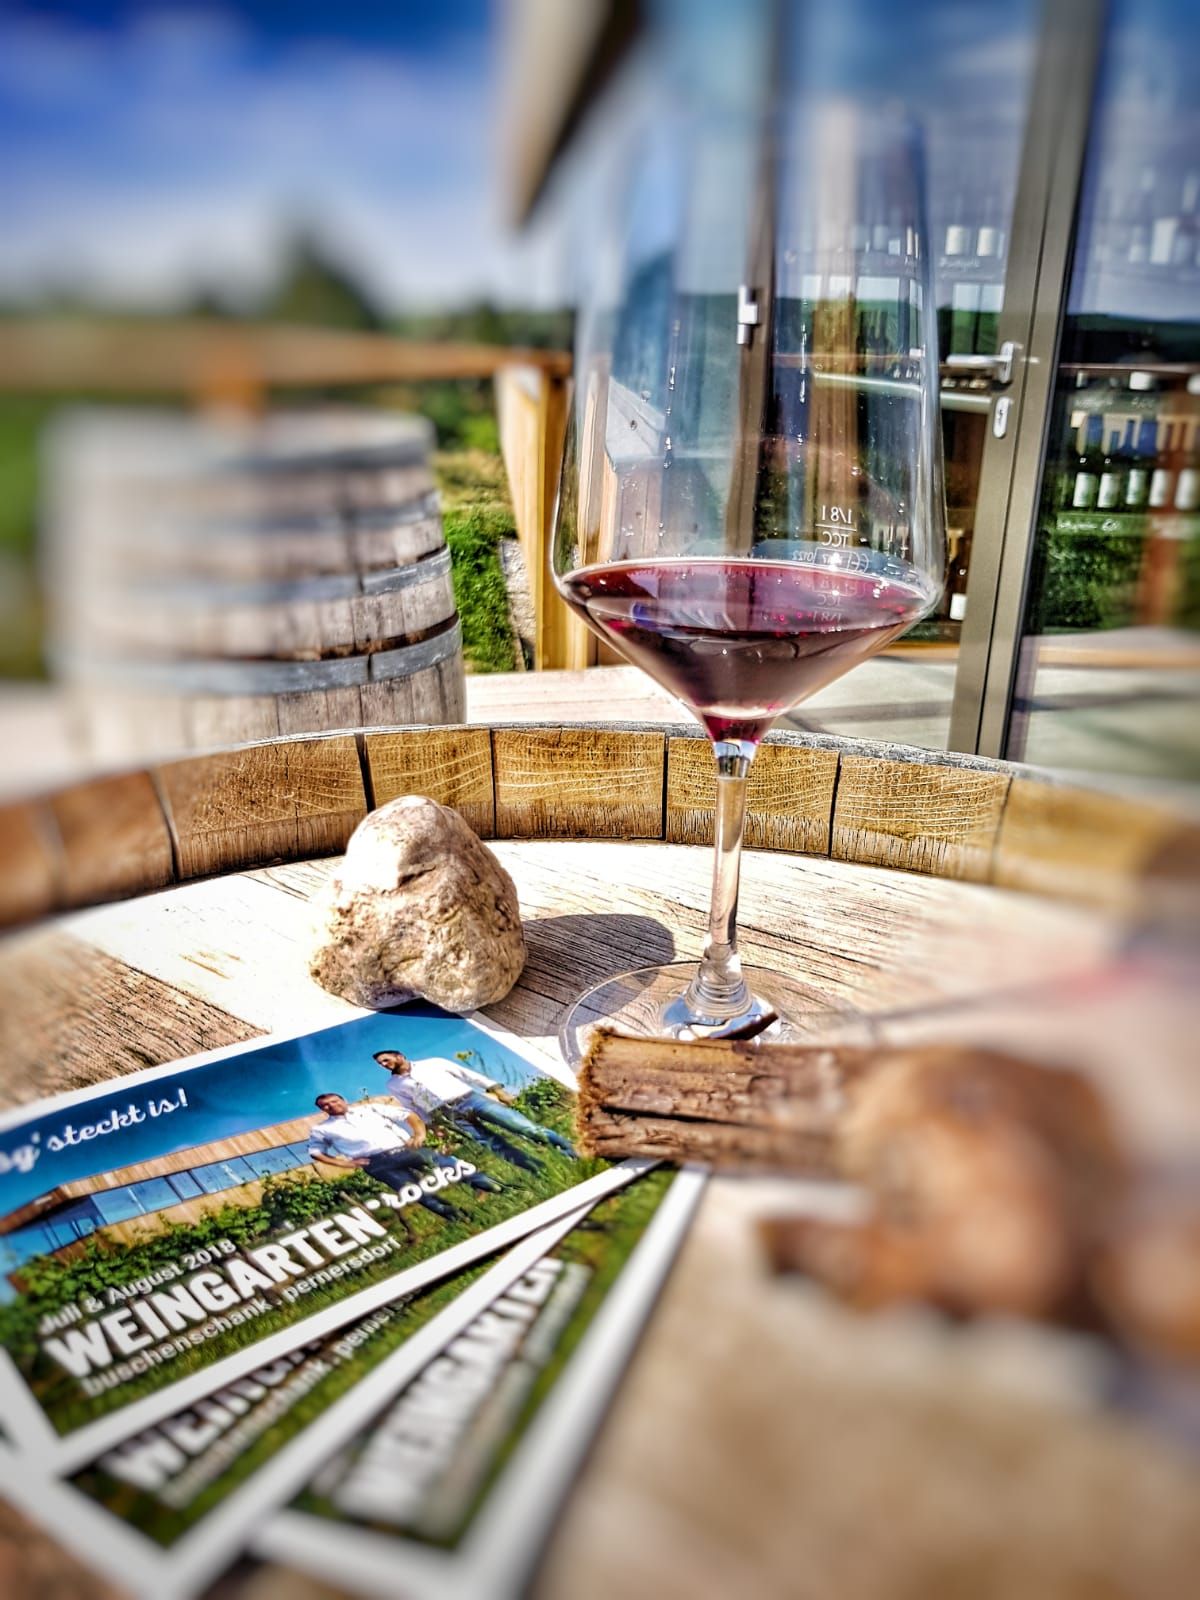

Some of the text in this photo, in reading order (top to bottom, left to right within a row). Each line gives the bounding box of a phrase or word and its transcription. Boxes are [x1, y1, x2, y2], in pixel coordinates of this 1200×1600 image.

[148, 1088, 188, 1118] is!
[42, 1205, 388, 1378] WEINGARTEN
[80, 1234, 402, 1397] buschenschank pernersdorf
[84, 1293, 106, 1314] &
[107, 1260, 185, 1305] August
[183, 1238, 238, 1271] 2018
